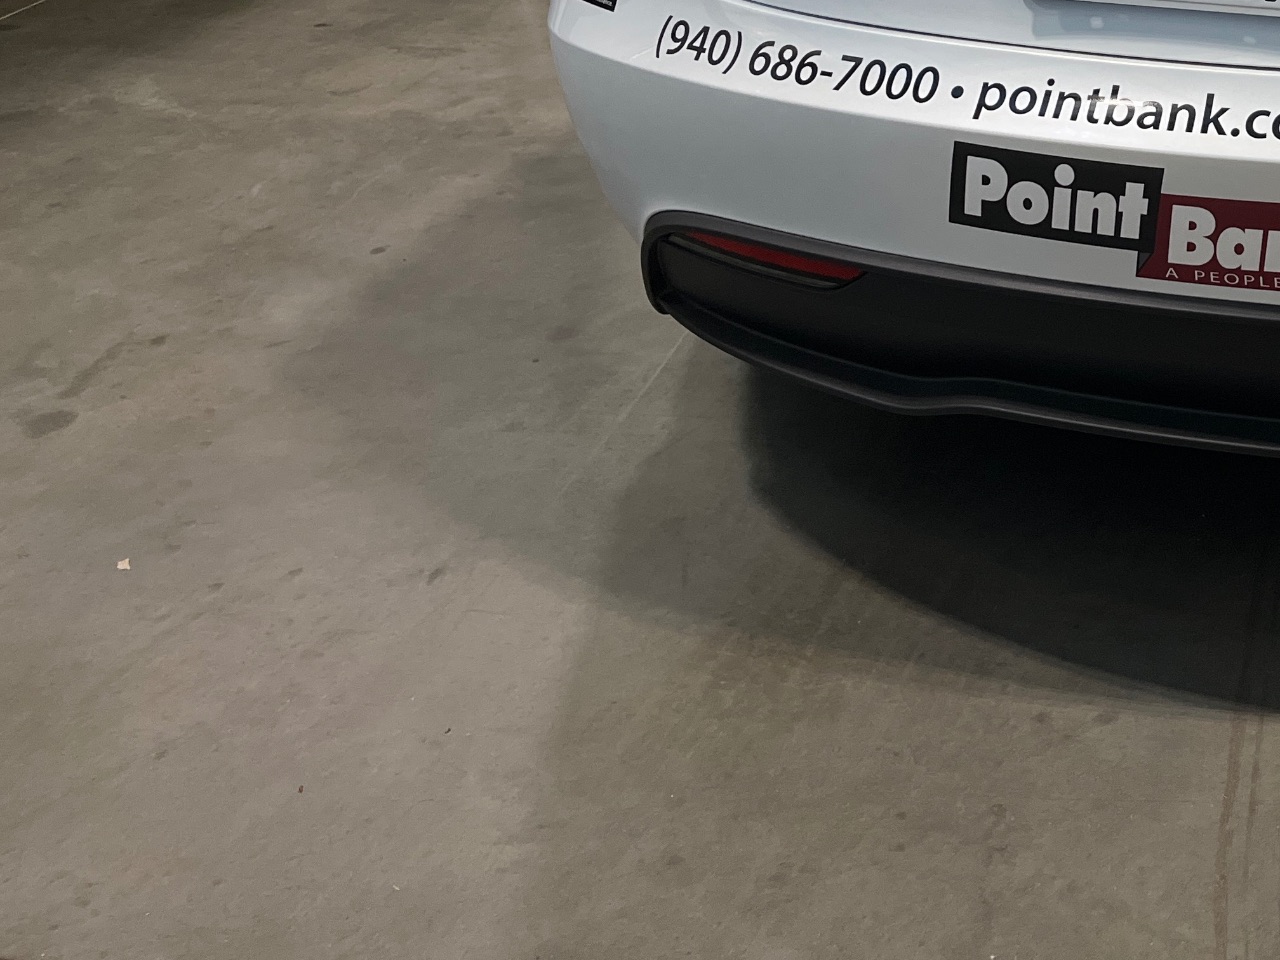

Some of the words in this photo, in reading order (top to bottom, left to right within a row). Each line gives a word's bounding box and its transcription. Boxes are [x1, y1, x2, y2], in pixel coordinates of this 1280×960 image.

[655, 14, 742, 75] (940)
[748, 39, 940, 104] 686-7000
[963, 155, 1149, 240] Point
[1165, 267, 1180, 279] A
